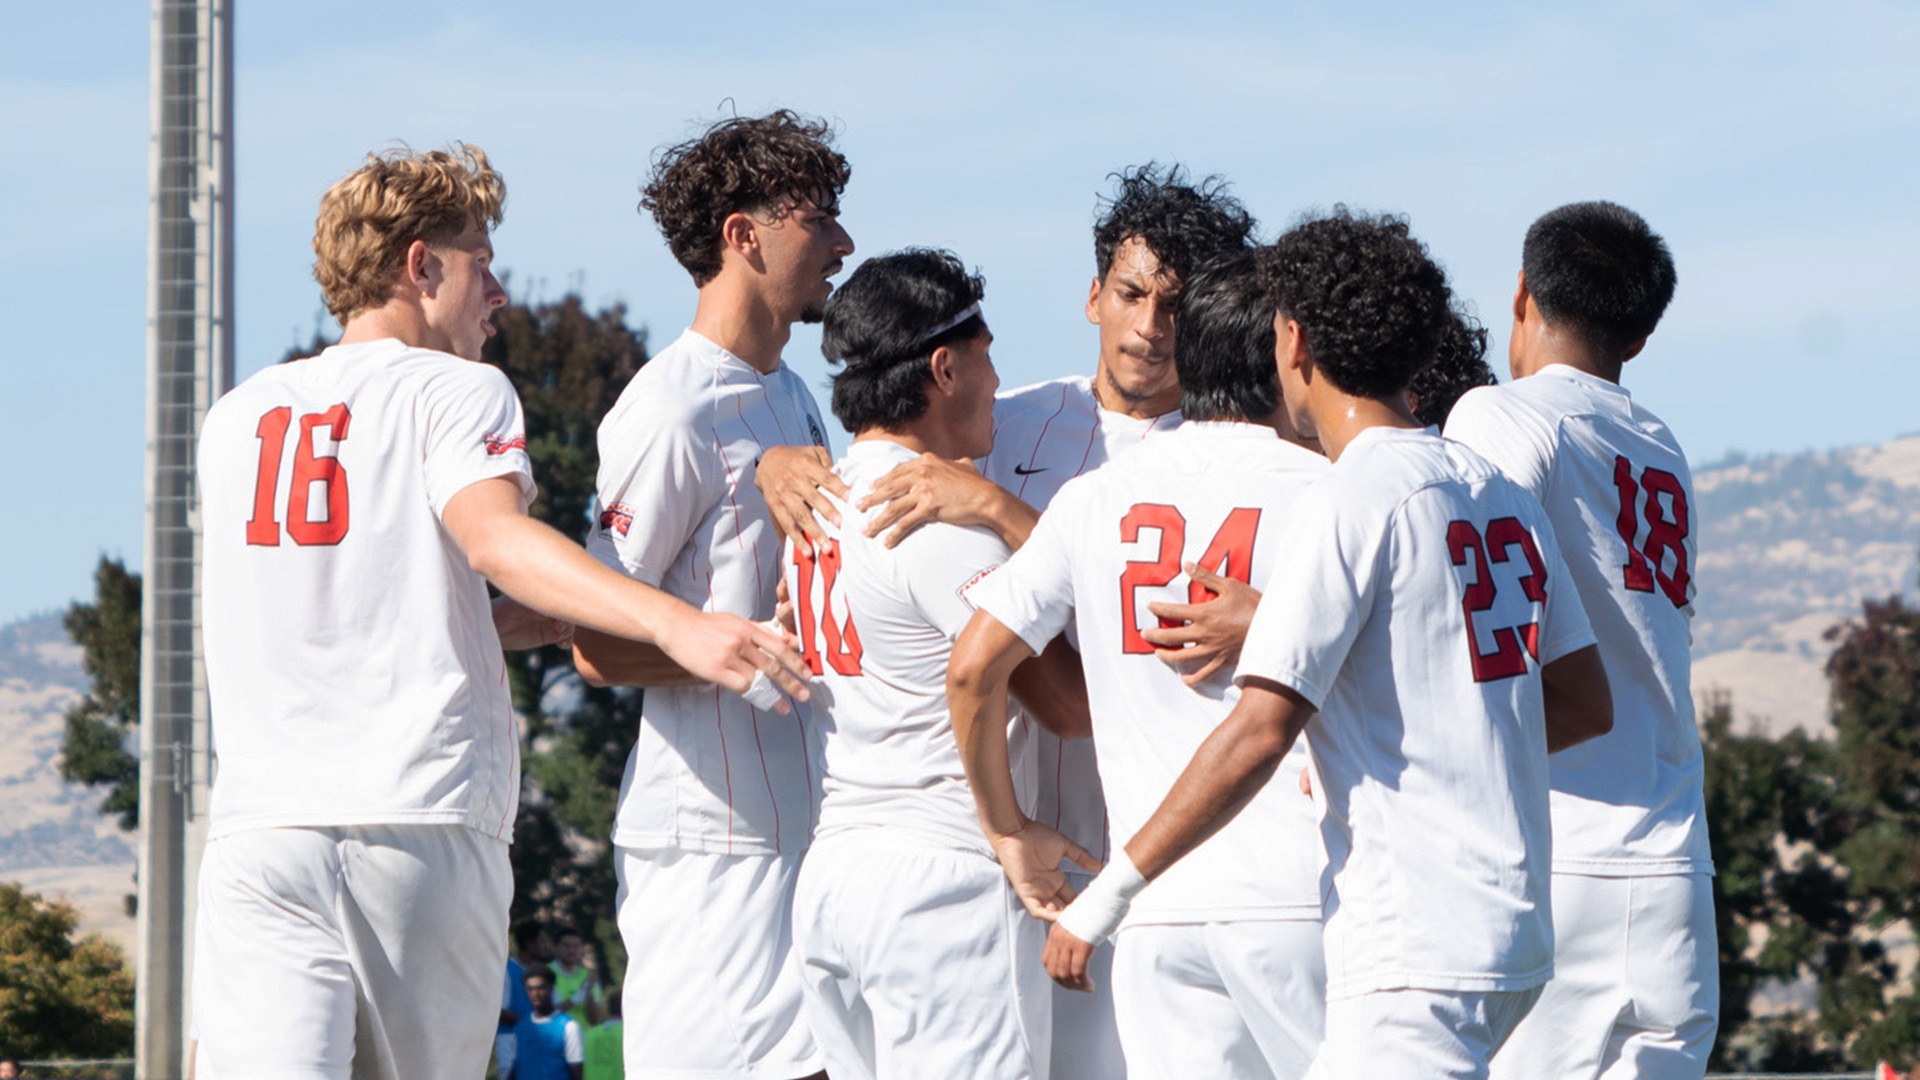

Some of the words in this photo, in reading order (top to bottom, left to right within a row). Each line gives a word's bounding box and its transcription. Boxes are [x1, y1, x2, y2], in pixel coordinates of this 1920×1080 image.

[247, 404, 350, 547] 16
[1614, 456, 1690, 607] 18
[1120, 503, 1262, 654] 24
[1446, 516, 1547, 682] 23
